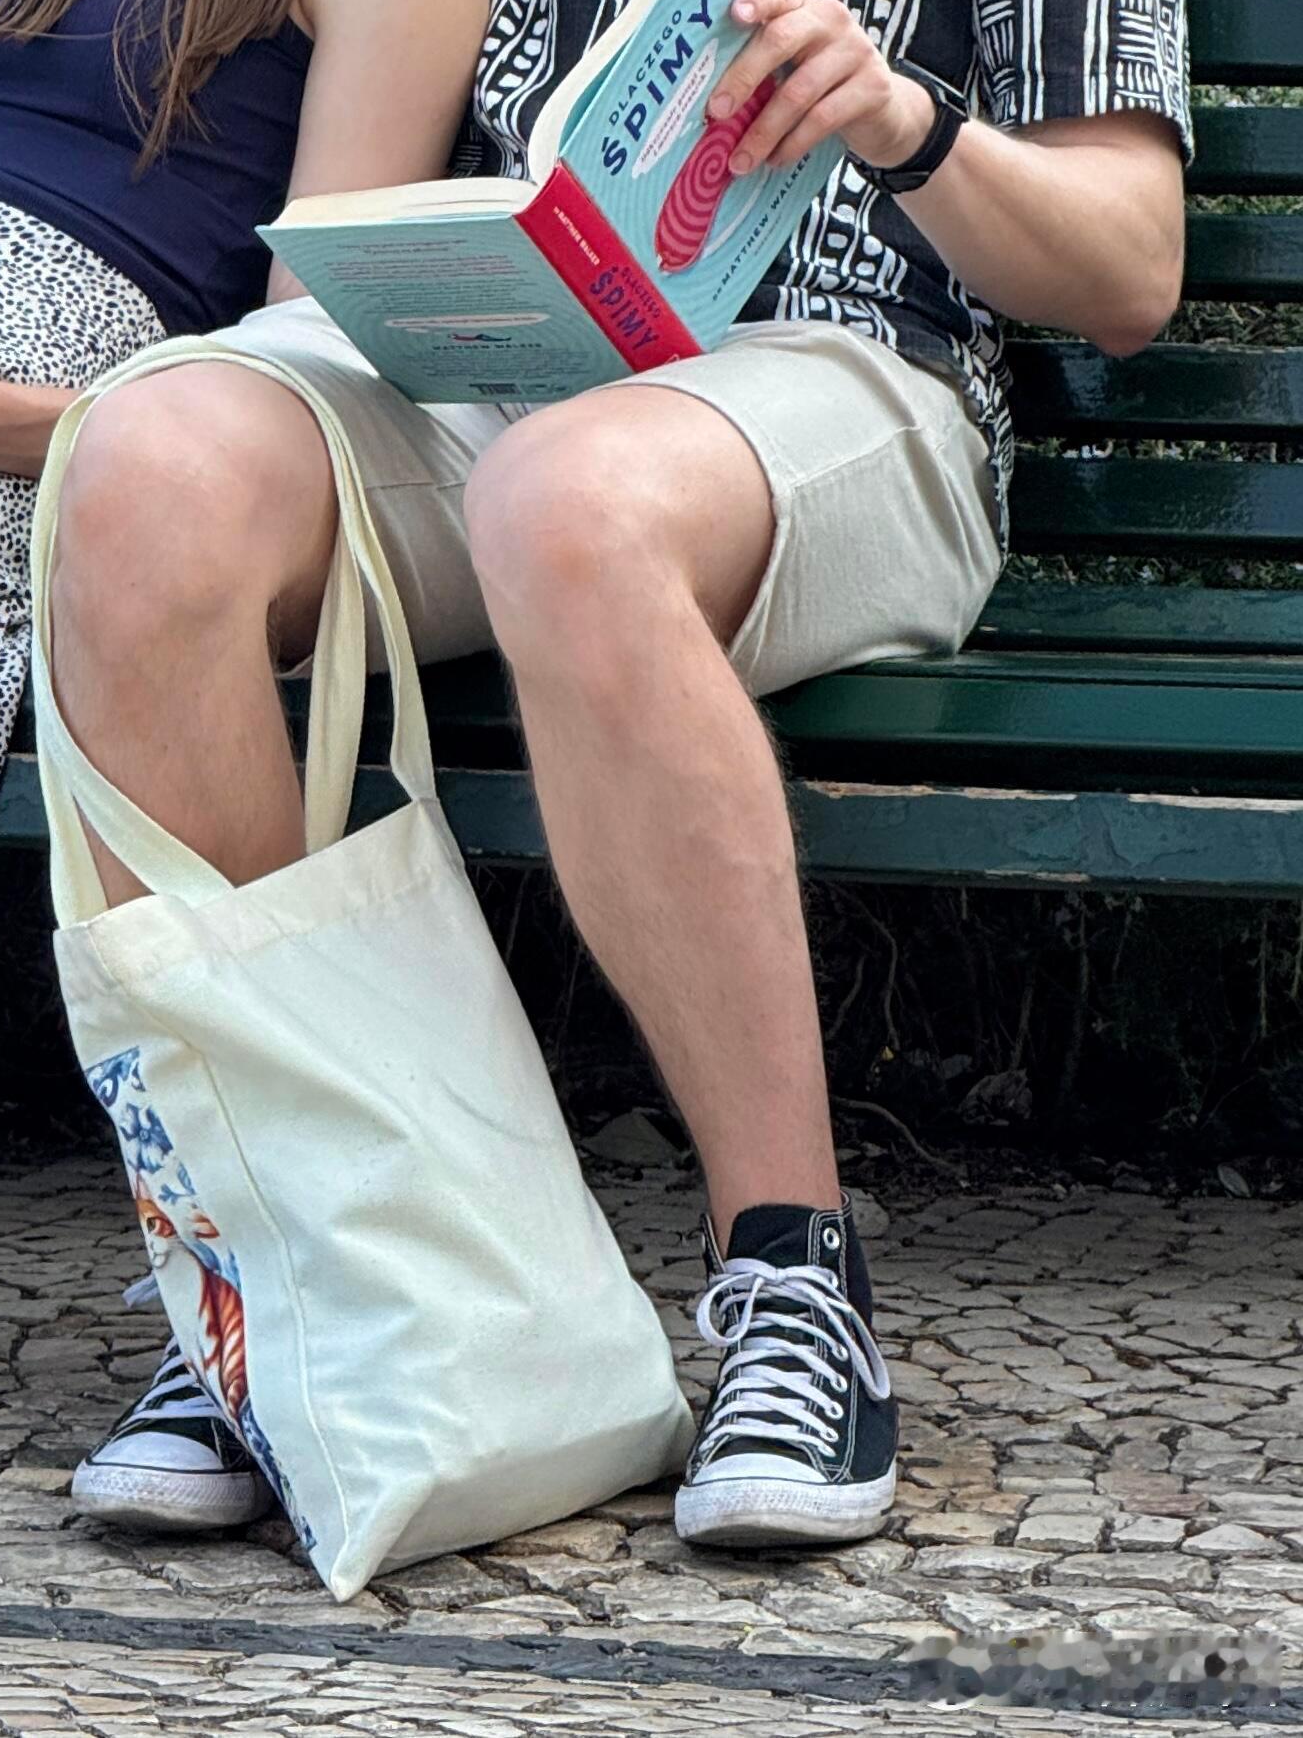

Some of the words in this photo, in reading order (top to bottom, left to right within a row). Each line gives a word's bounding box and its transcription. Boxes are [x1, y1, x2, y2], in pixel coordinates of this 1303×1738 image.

[608, 10, 682, 127] DLACZEGO
[721, 214, 769, 285] MATTHEW
[770, 152, 811, 210] WALKER
[589, 265, 660, 351] ŚPIMY
